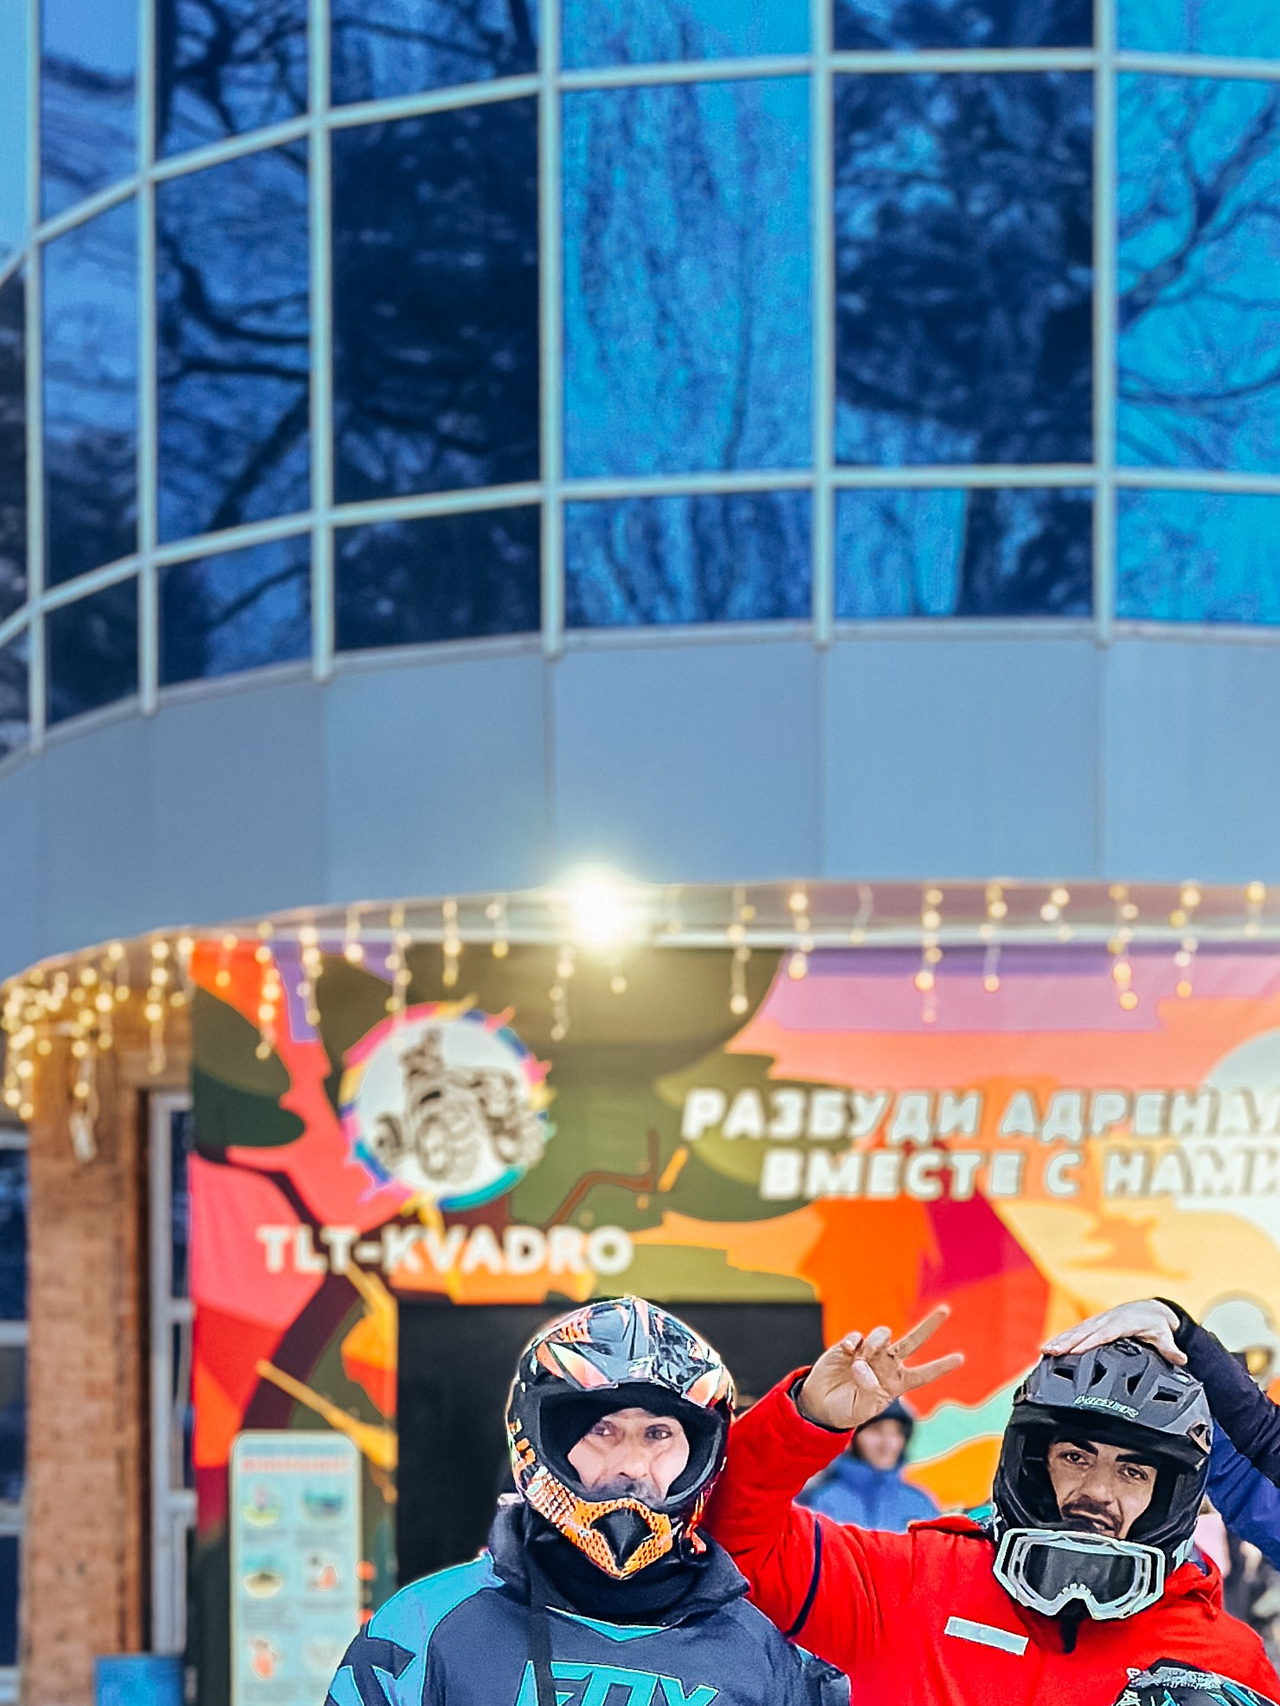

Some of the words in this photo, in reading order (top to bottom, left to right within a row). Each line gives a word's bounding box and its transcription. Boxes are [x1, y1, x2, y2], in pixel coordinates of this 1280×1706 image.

[681, 1087, 984, 1144] РАЗБУДИ
[759, 1149, 1026, 1200] ВМЕСТЕ
[1045, 1151, 1084, 1197] С
[256, 1223, 636, 1275] TLT-KVADRO
